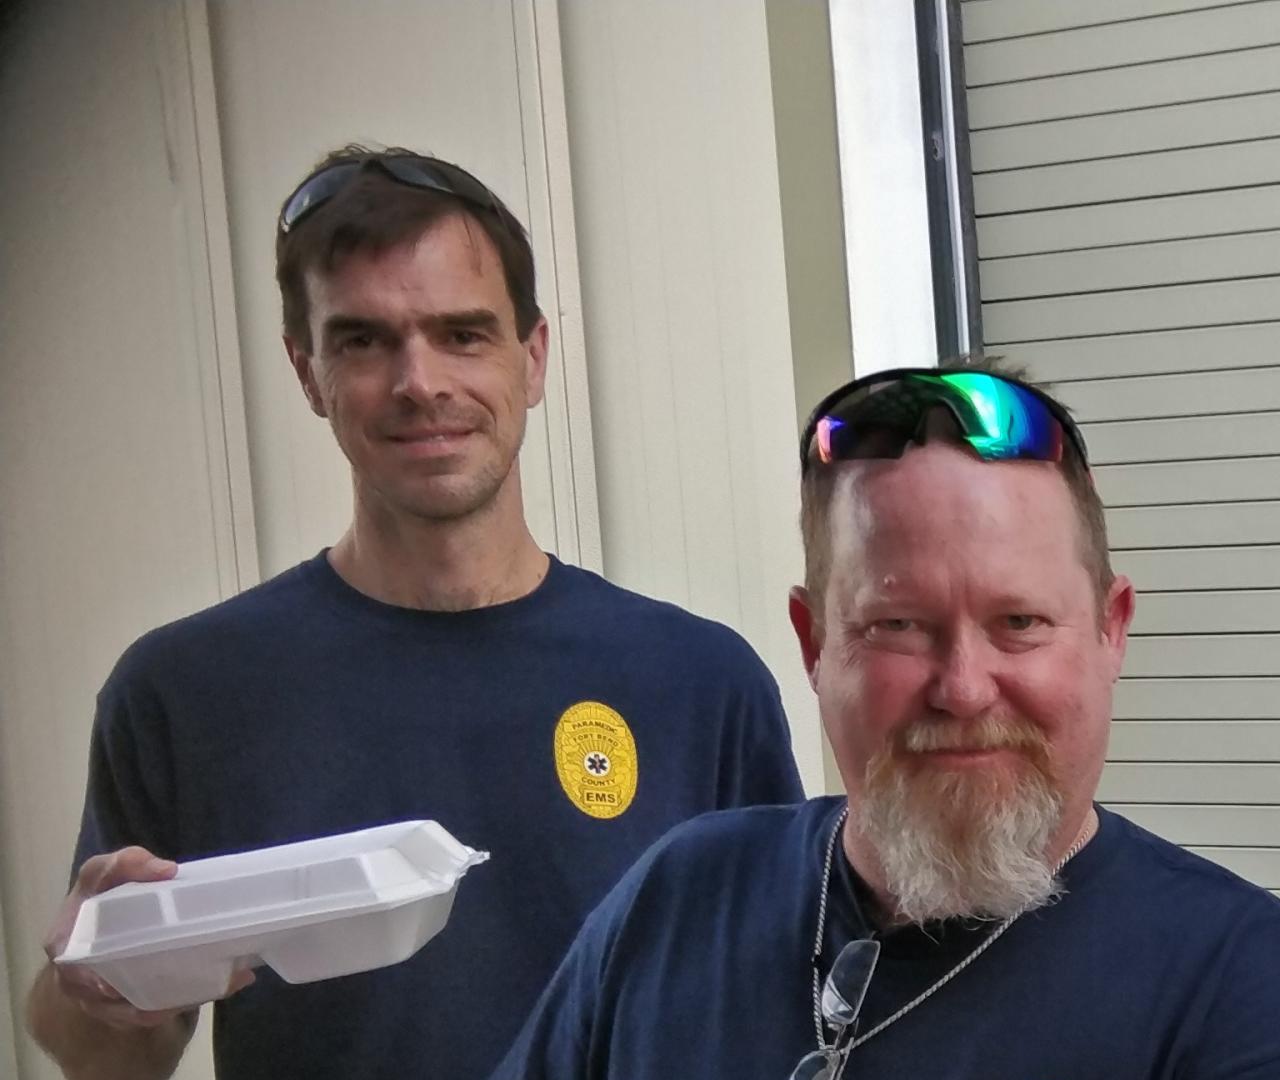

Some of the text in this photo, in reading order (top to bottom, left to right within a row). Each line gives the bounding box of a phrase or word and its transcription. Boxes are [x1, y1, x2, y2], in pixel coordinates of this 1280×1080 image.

[572, 721, 618, 735] PARAMEDIC
[581, 776, 616, 787] COUNTY
[586, 792, 616, 803] EMS
